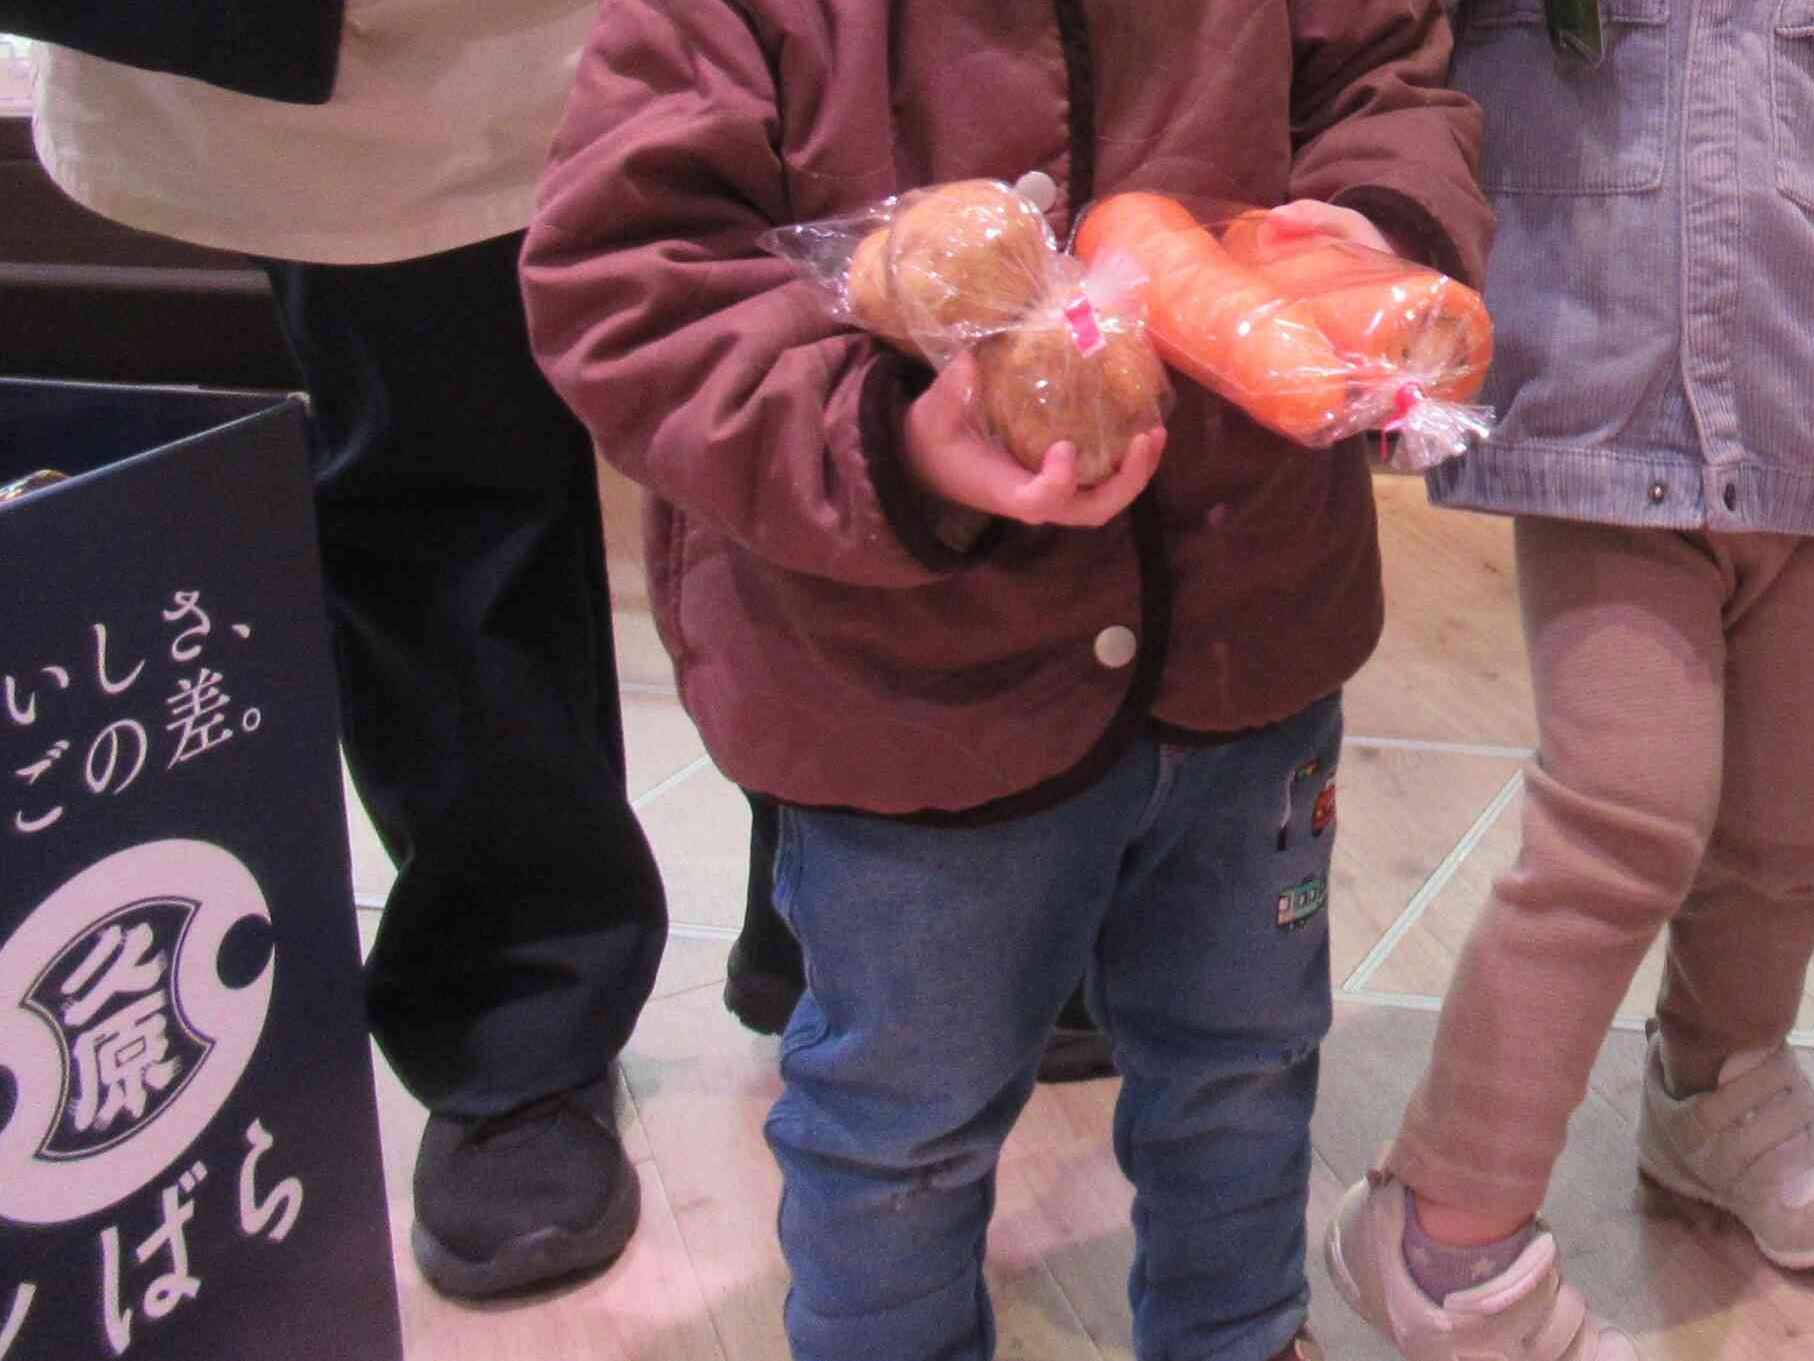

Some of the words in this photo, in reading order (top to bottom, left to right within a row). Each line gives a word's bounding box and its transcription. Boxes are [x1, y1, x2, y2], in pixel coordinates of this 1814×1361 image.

[5, 590, 251, 725] いしさ、
[15, 667, 262, 832] ごの差。
[61, 922, 182, 1132] 久原
